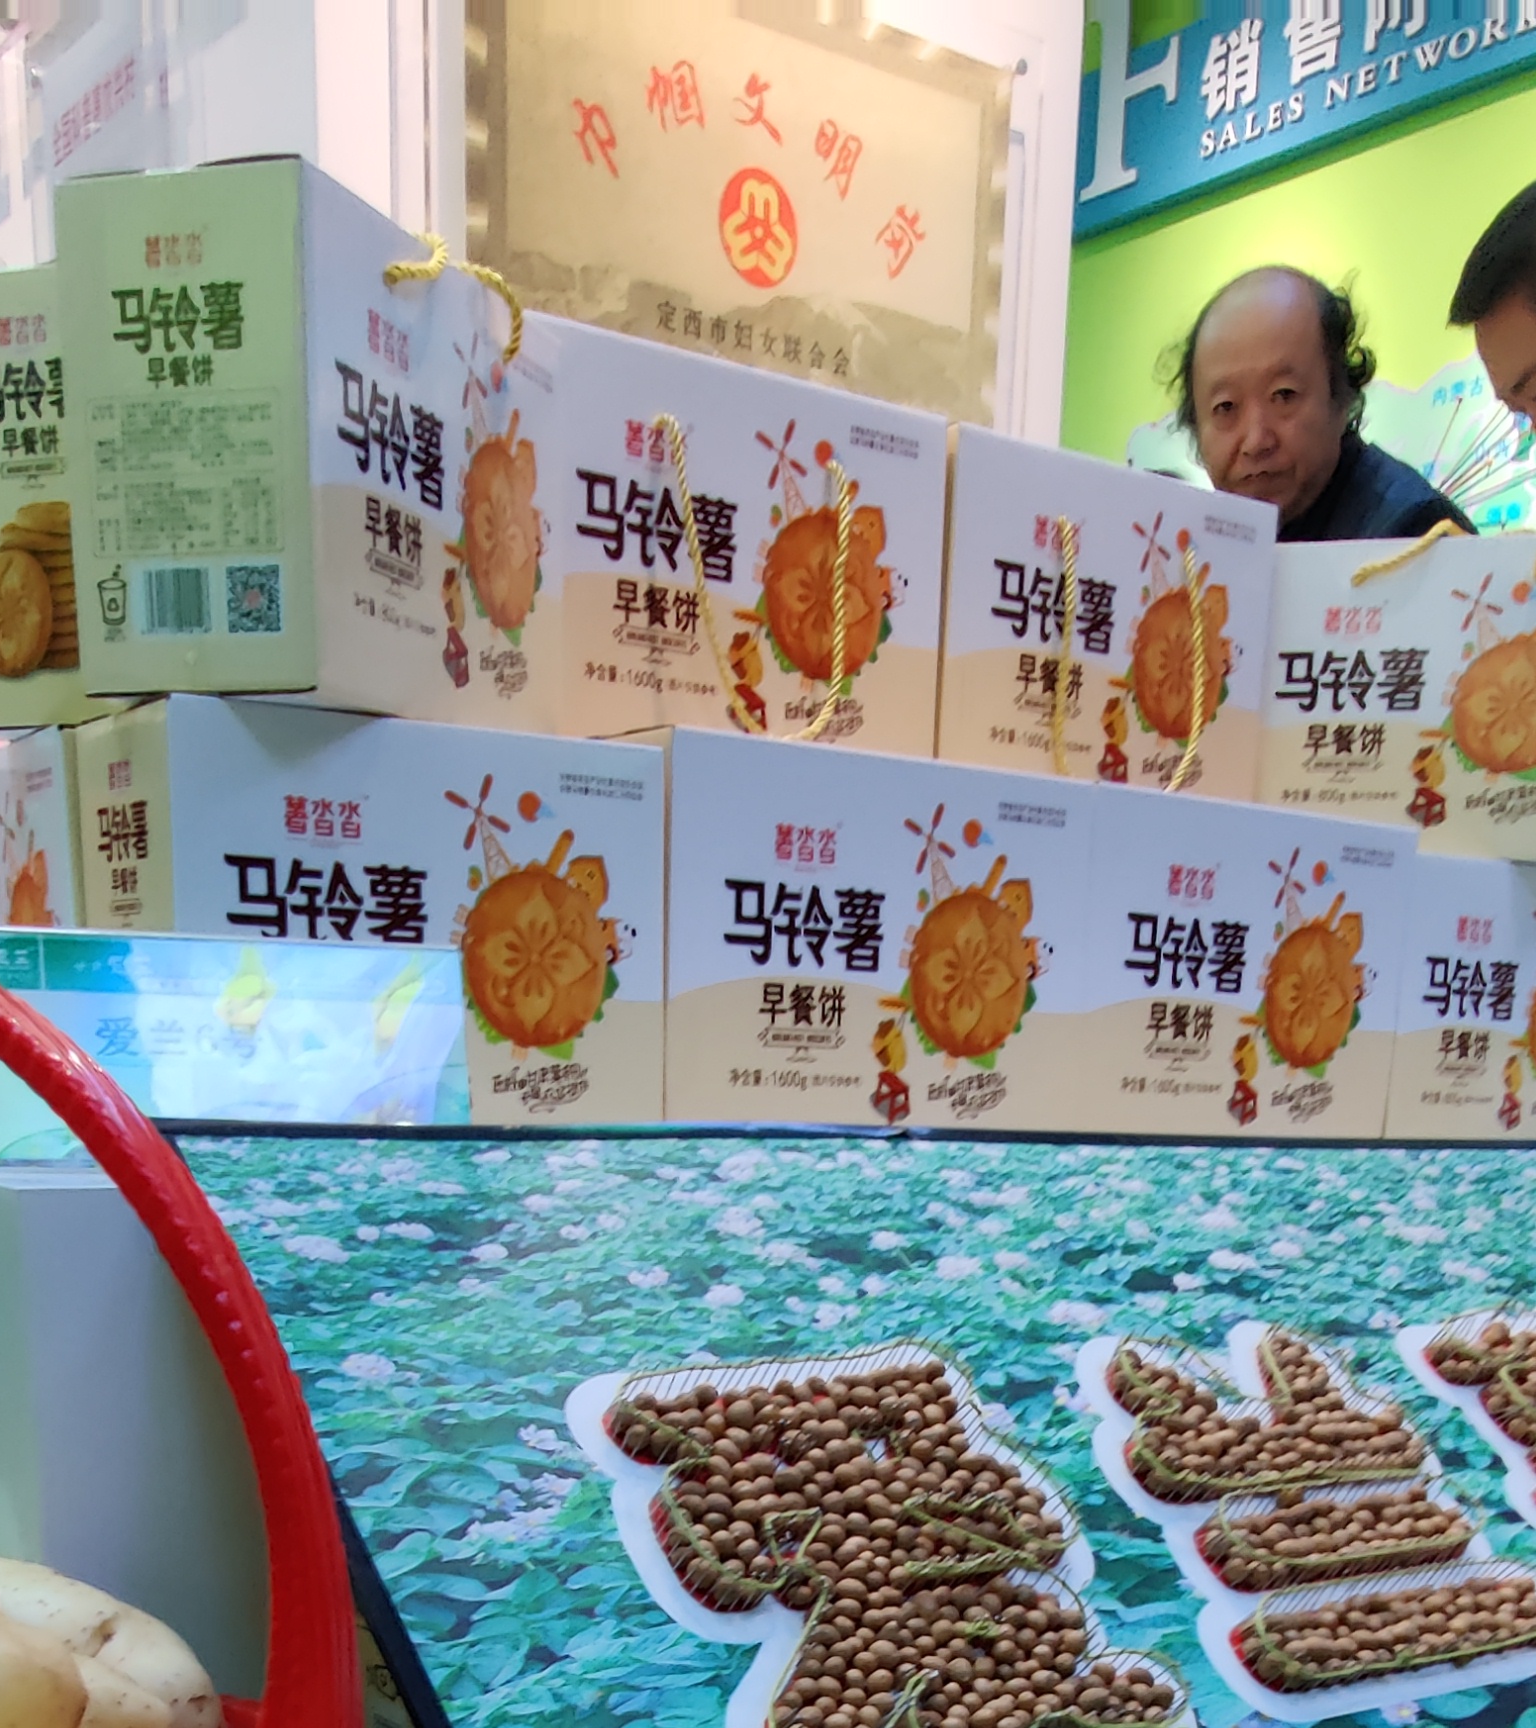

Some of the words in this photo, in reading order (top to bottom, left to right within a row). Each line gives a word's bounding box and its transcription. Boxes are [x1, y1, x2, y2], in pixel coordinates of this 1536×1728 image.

[1200, 93, 1305, 158] SALES
[111, 281, 244, 354] 马铃薯
[656, 300, 852, 379] 定西市妇女联合会
[147, 355, 215, 388] 早餐饼
[1, 426, 61, 457] 早餐饼
[335, 357, 445, 512] 马铃薯
[364, 496, 424, 569] 早餐饼
[576, 468, 739, 583] 马铃薯
[613, 578, 701, 635] 早餐饼
[991, 558, 1117, 655] 马铃薯
[1275, 647, 1430, 713] 马铃薯
[1302, 723, 1386, 758] 早餐饼
[97, 800, 149, 863] 马铃薯
[224, 853, 428, 944] 马铃薯
[723, 878, 886, 973] 马铃薯
[1124, 912, 1251, 994] 马铃薯
[758, 982, 847, 1027] 早餐饼
[1423, 956, 1520, 1022] 马铃薯
[1146, 1002, 1215, 1043] 早餐饼
[1438, 1029, 1492, 1060] 早餐饼
